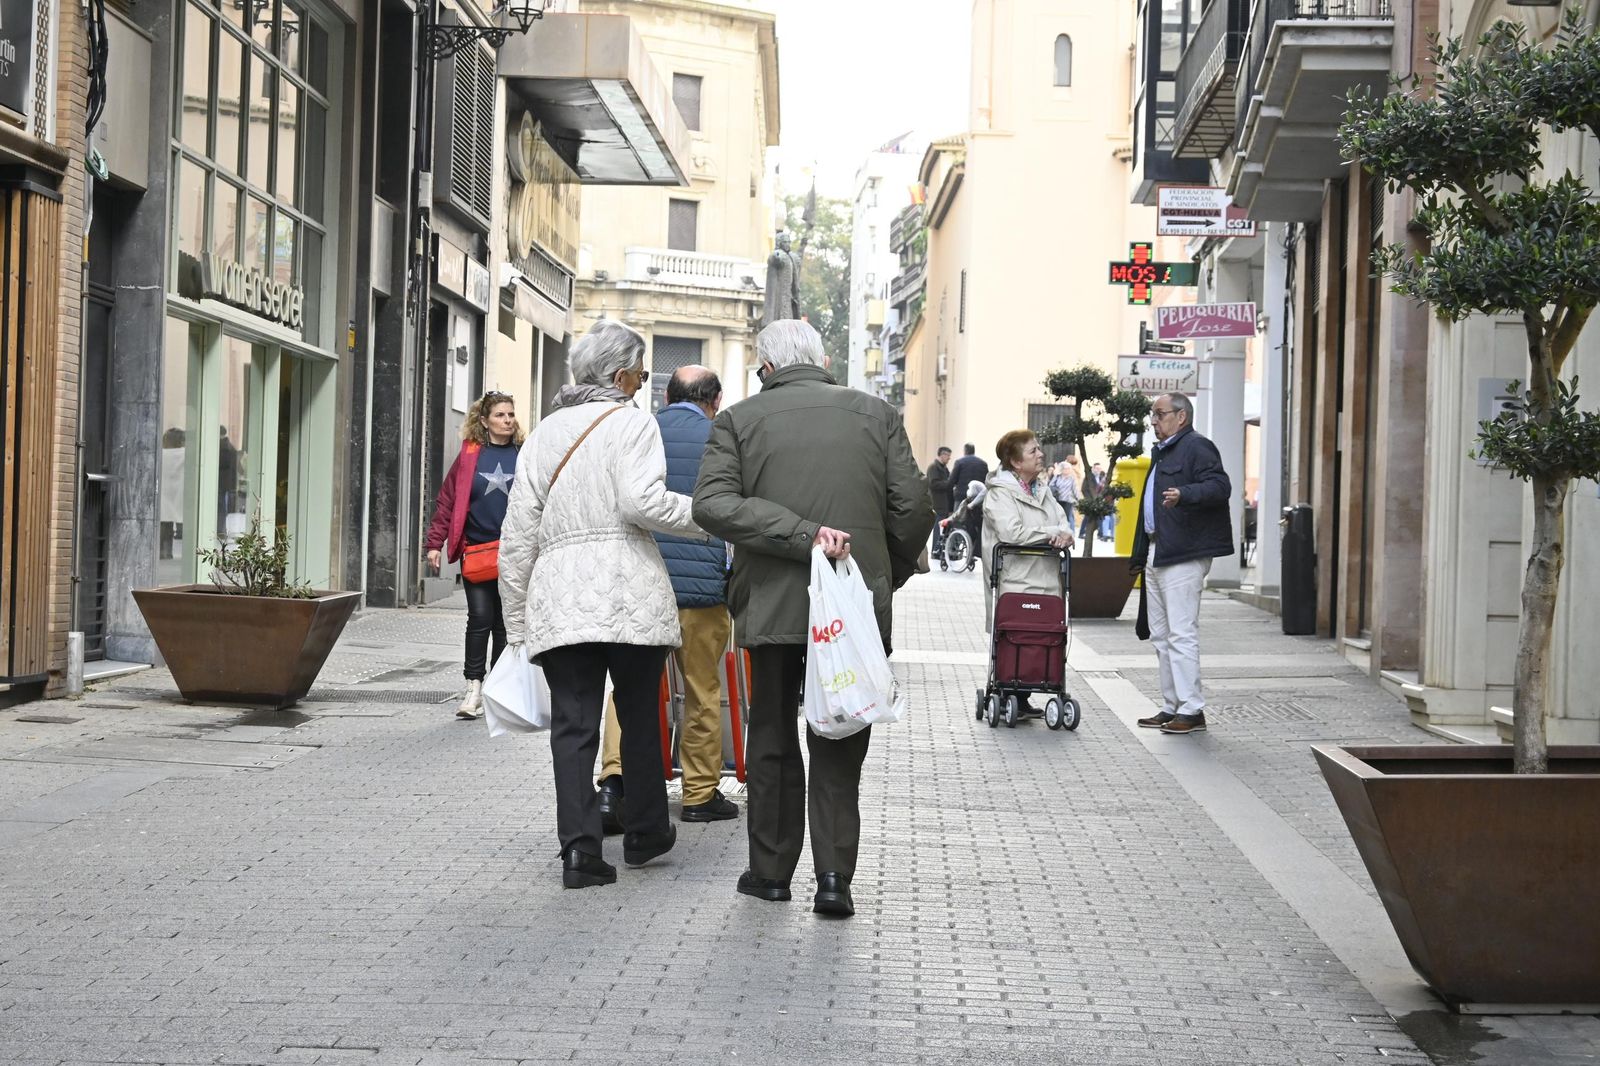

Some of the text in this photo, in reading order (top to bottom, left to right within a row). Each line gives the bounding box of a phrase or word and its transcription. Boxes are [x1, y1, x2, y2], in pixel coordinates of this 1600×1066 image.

[1162, 208, 1220, 216] CGT-HUELVA
[1227, 219, 1251, 228] CGT
[1160, 303, 1252, 327] PELUQUERIA
[1177, 318, 1232, 338] Jose
[1149, 360, 1191, 370] Estética
[1120, 377, 1183, 390] CARHEL
